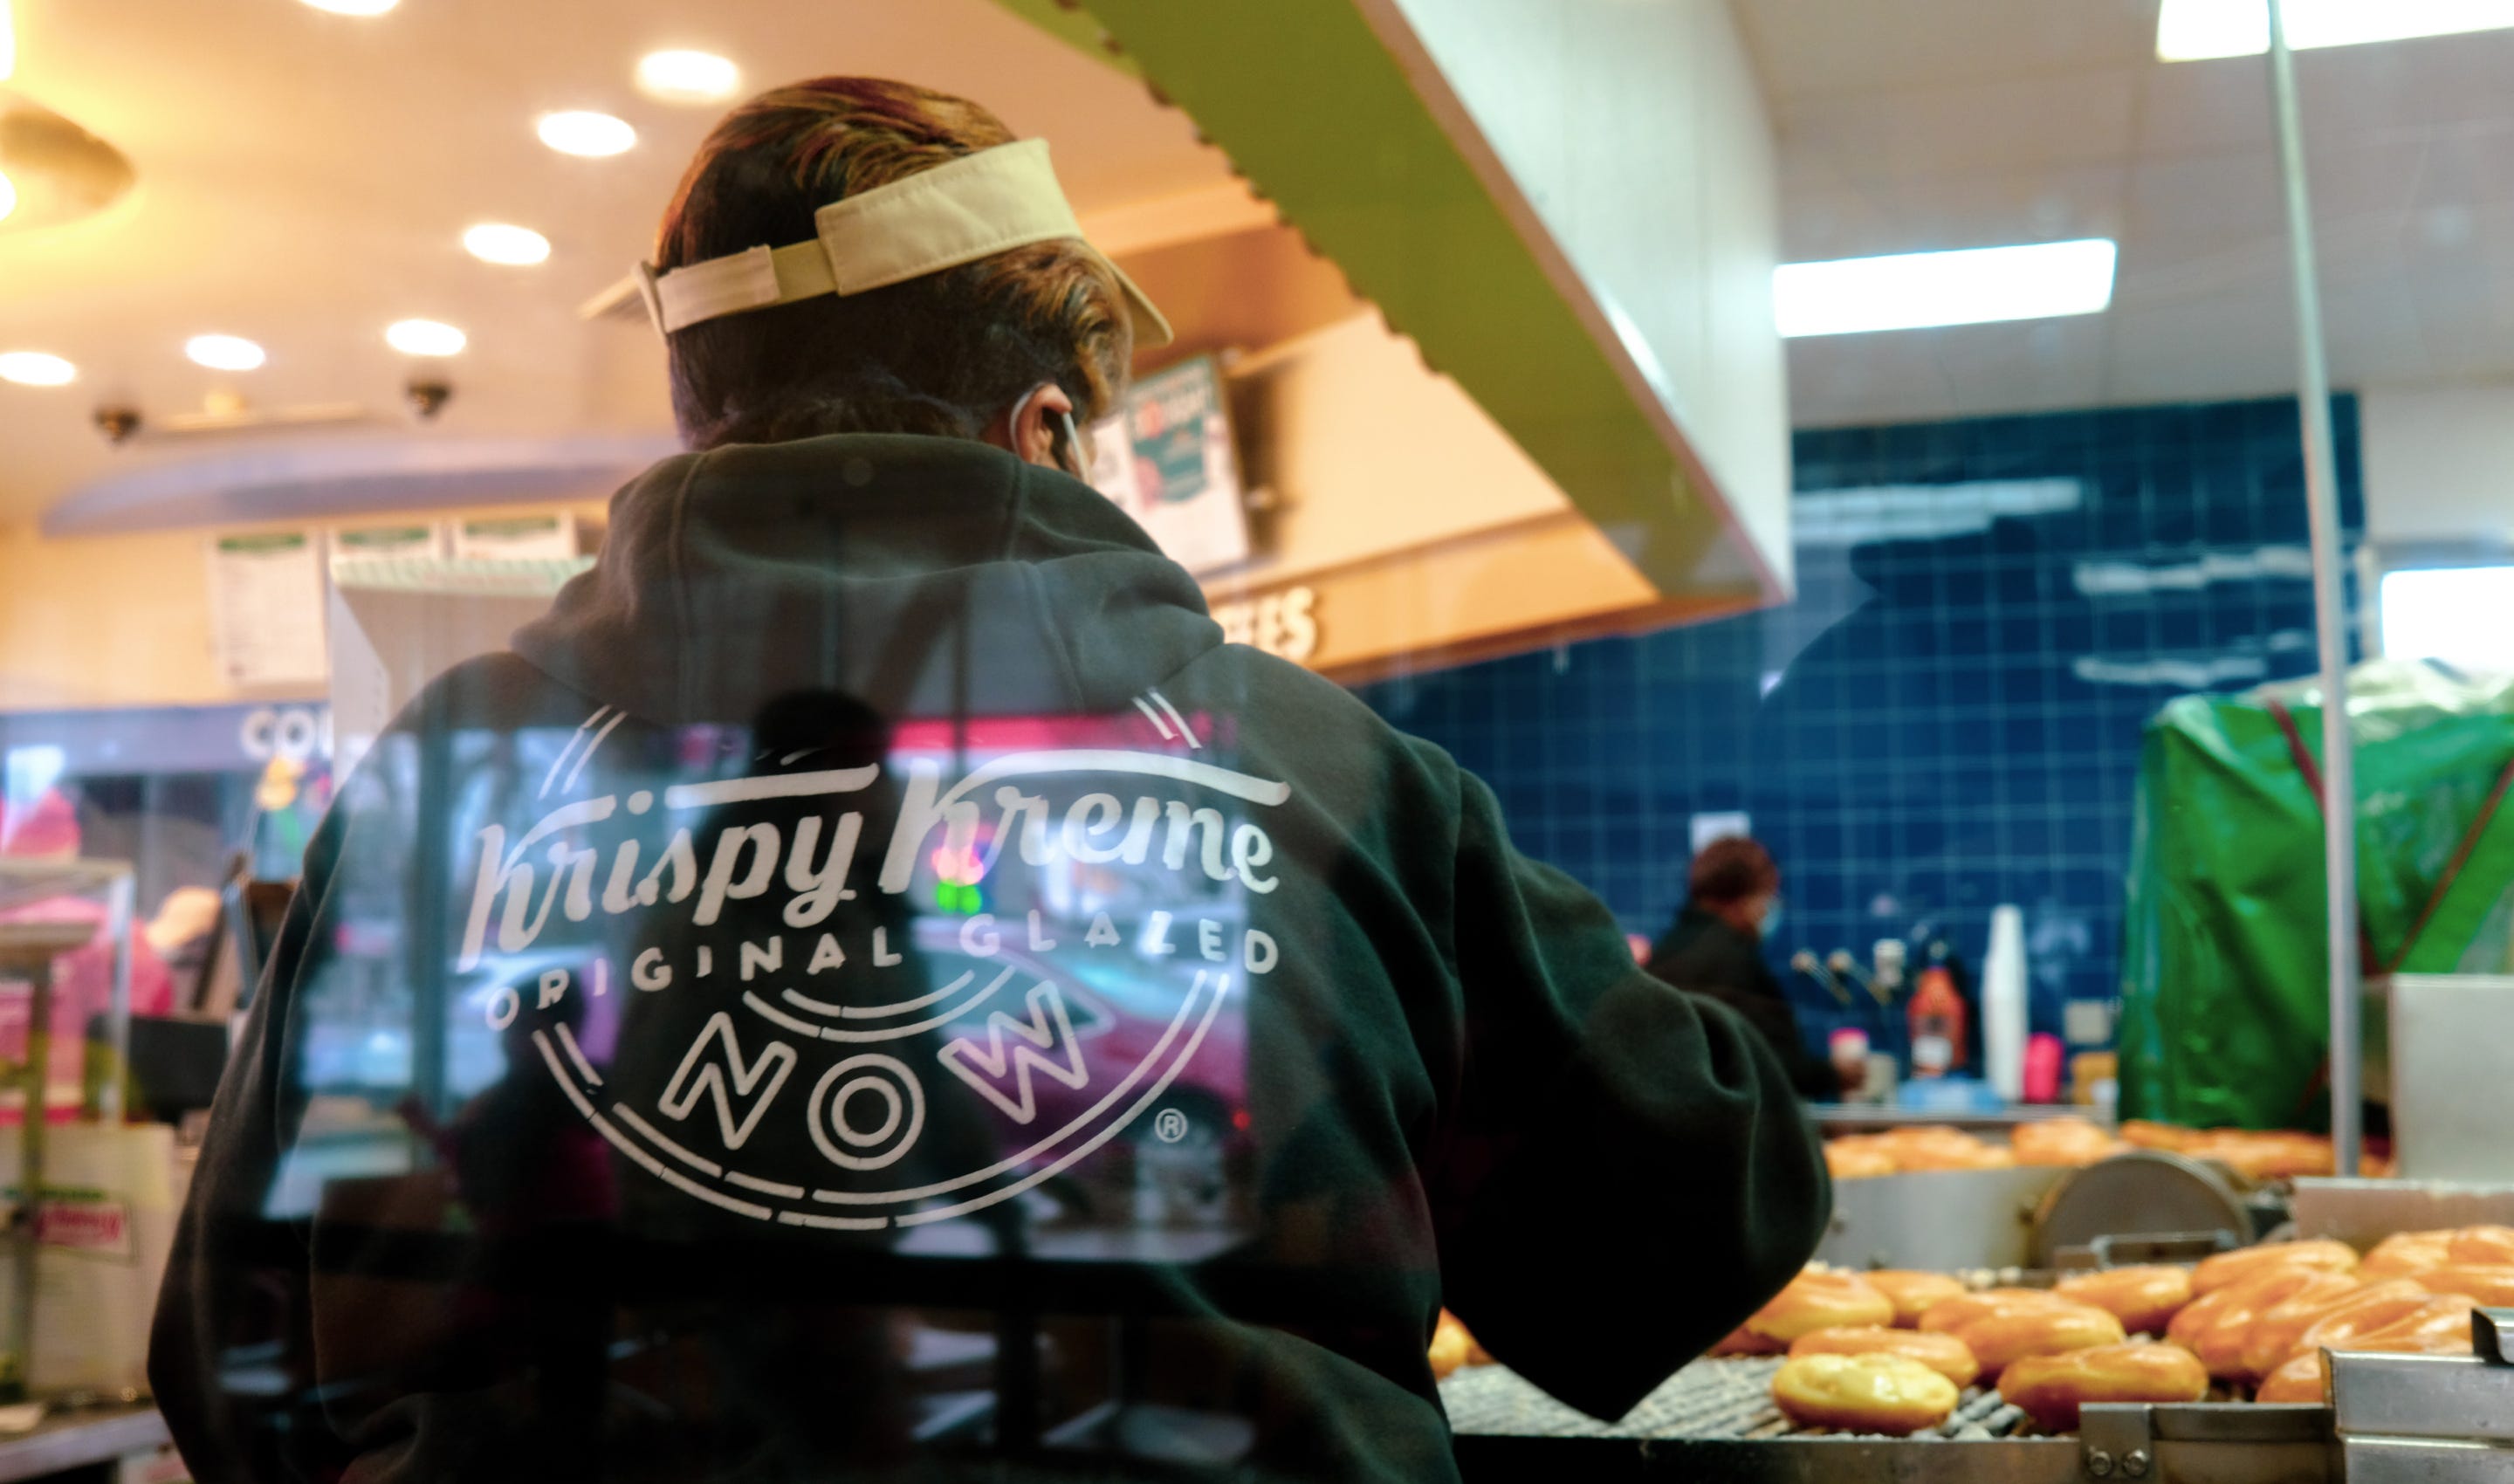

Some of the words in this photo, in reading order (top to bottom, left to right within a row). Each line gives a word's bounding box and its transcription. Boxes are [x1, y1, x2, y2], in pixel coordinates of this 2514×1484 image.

[456, 763, 878, 973] Krispy
[878, 749, 1291, 894] Kreme
[485, 925, 903, 1032] ORIGINAL
[960, 910, 1279, 975] GLAZED
[657, 979, 1089, 1171] NOW
